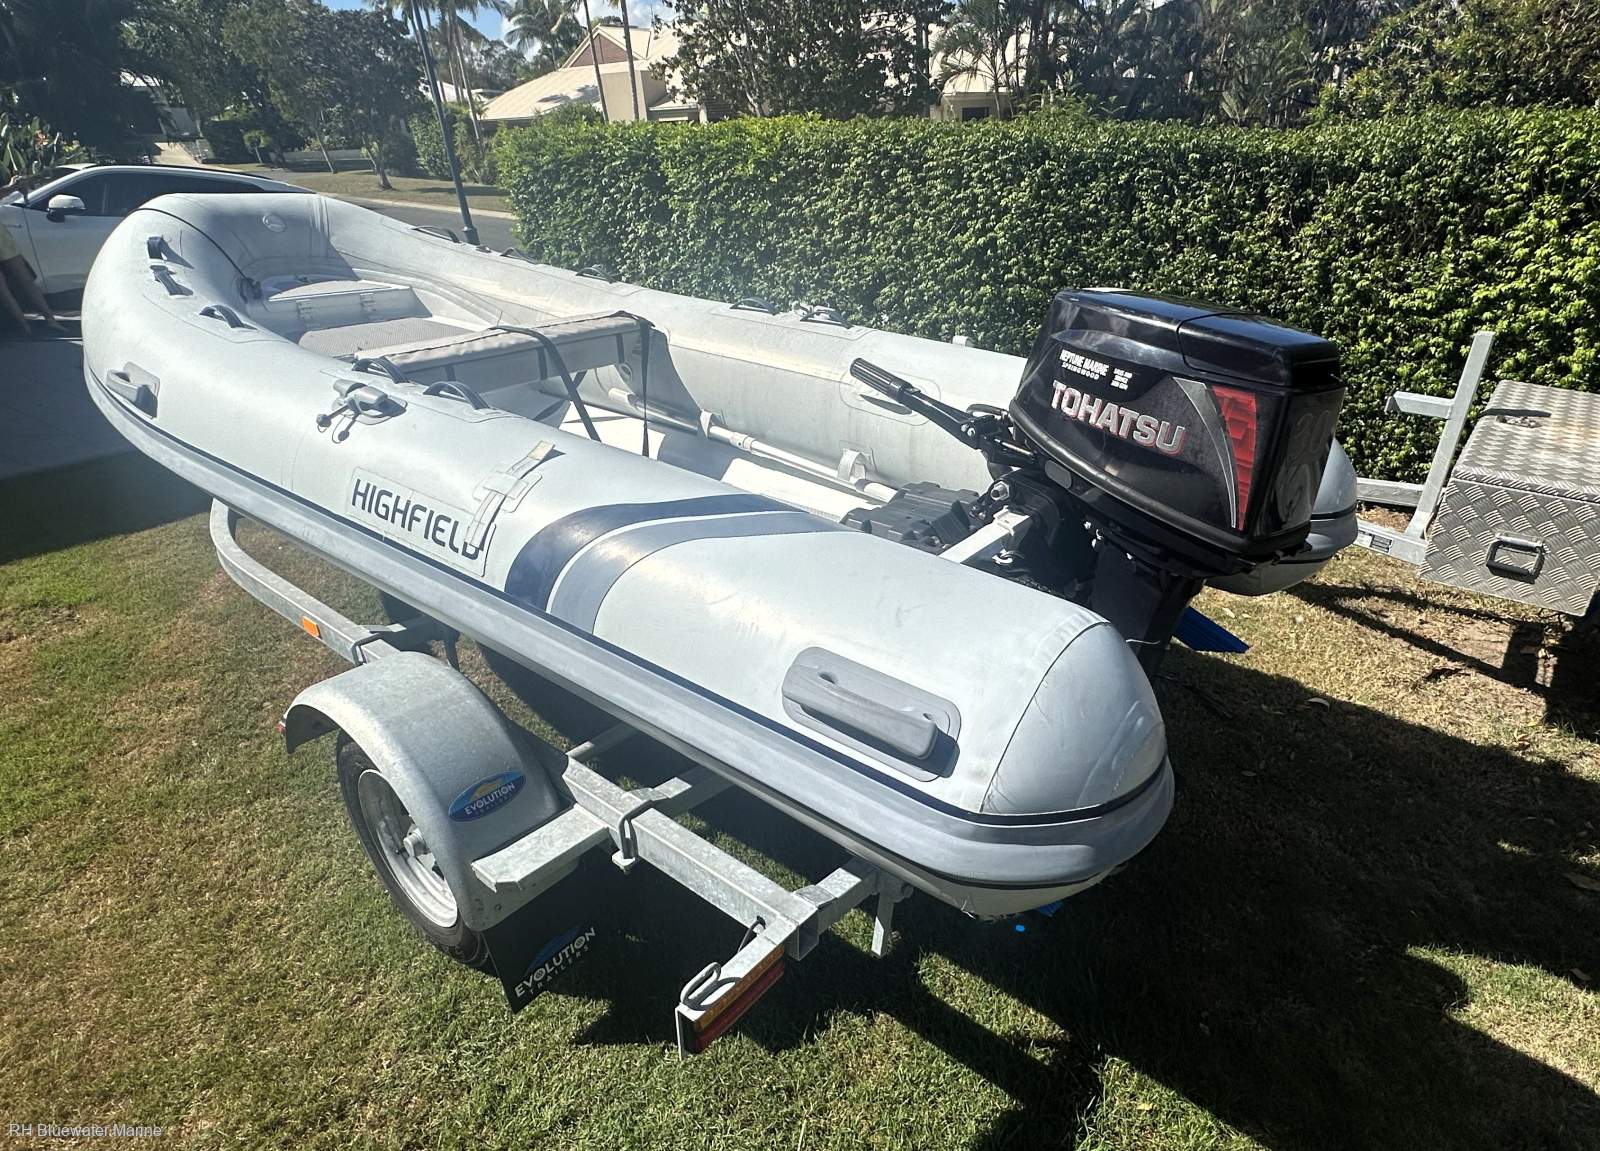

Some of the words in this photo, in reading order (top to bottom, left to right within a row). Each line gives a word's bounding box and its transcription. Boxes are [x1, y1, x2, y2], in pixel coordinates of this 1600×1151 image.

[1060, 349, 1085, 367] NEPTUNE
[1083, 358, 1109, 376] MARINE
[1061, 362, 1100, 380] SPRINGWOOD
[1051, 381, 1186, 455] TOHATSU
[464, 782, 515, 815] EVOLUTION
[514, 926, 596, 997] EVOLUTION
[529, 944, 589, 995] TRAILERS
